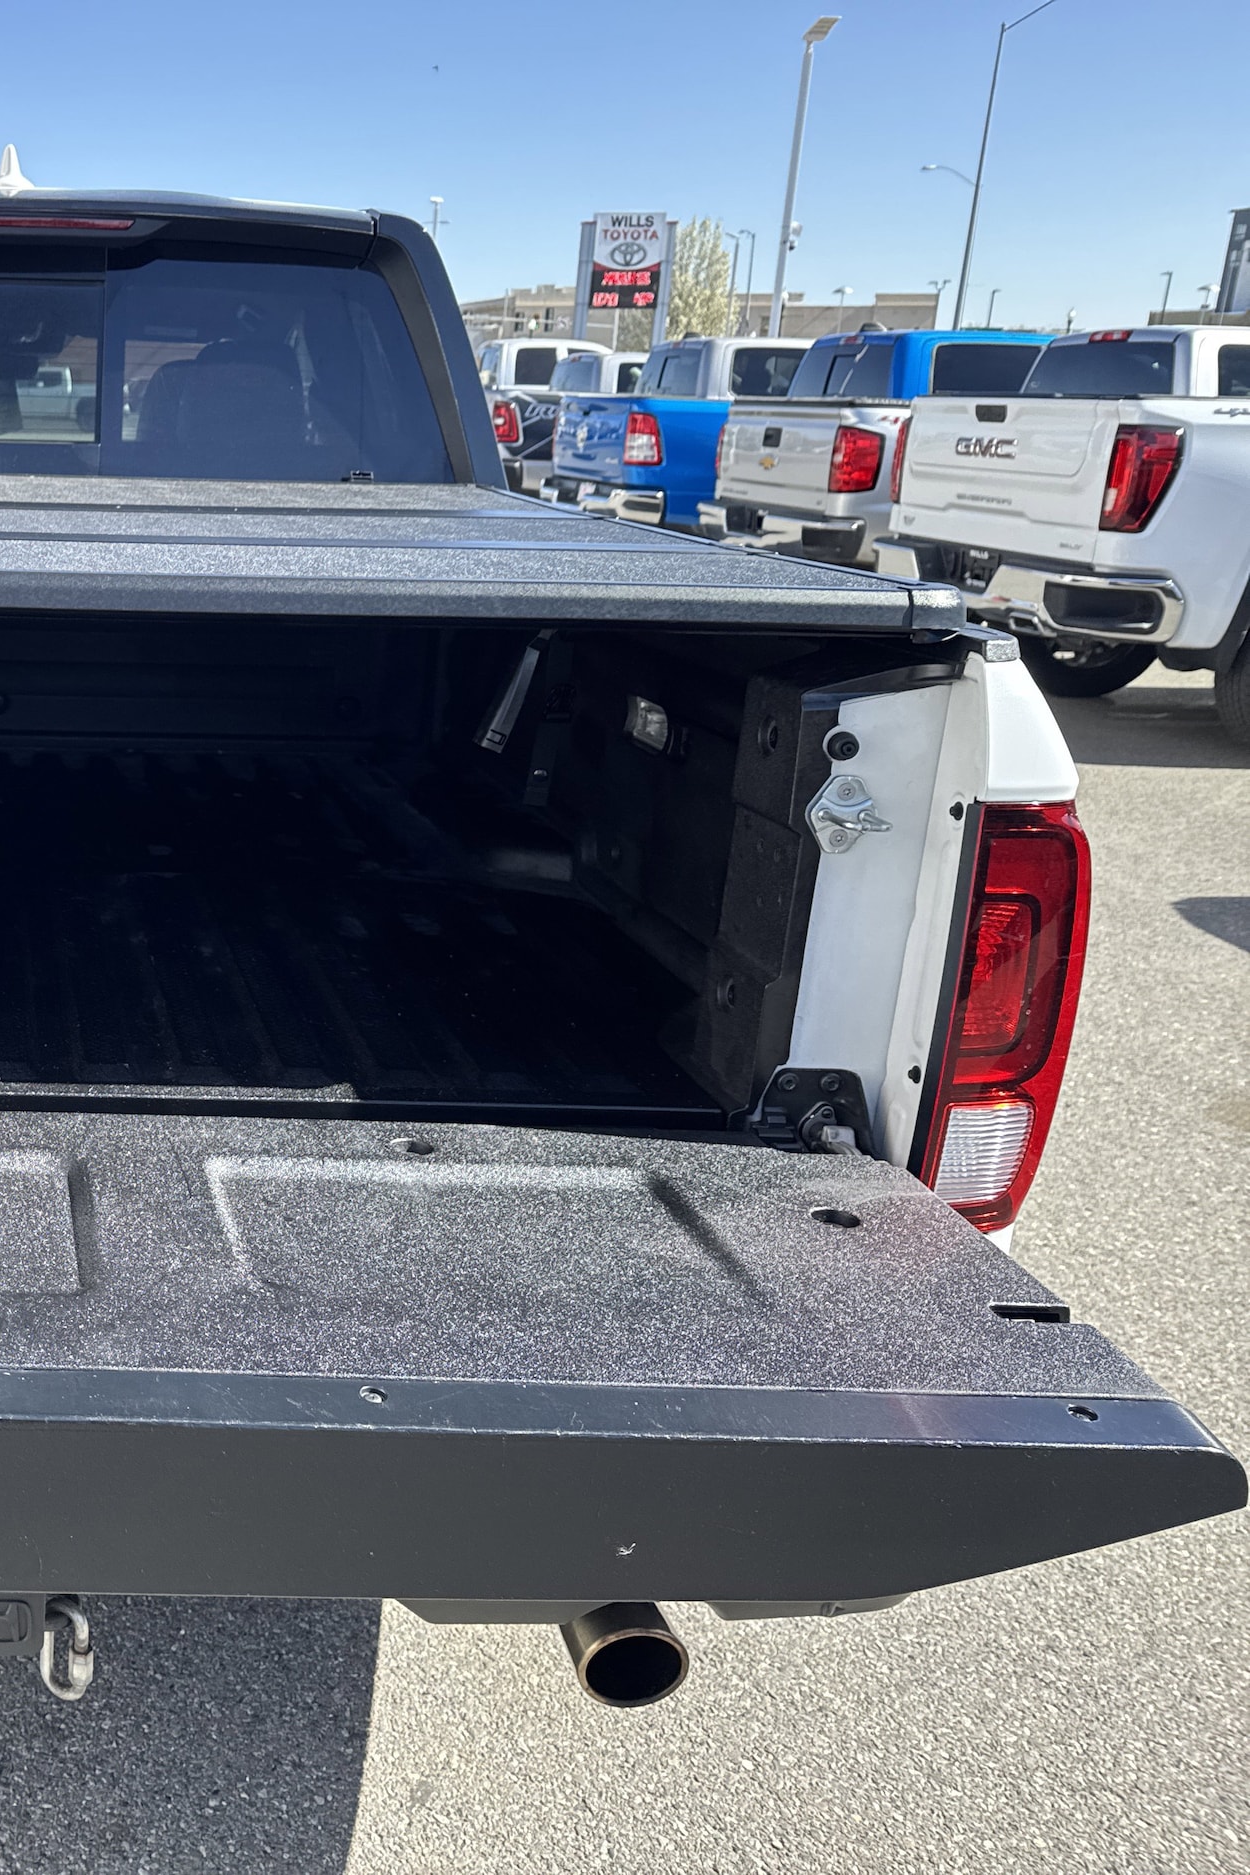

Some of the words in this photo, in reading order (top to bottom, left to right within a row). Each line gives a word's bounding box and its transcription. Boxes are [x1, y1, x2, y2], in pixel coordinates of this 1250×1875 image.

[611, 215, 654, 228] WILLS
[602, 229, 658, 240] TOYOTA
[955, 437, 1017, 459] GMC
